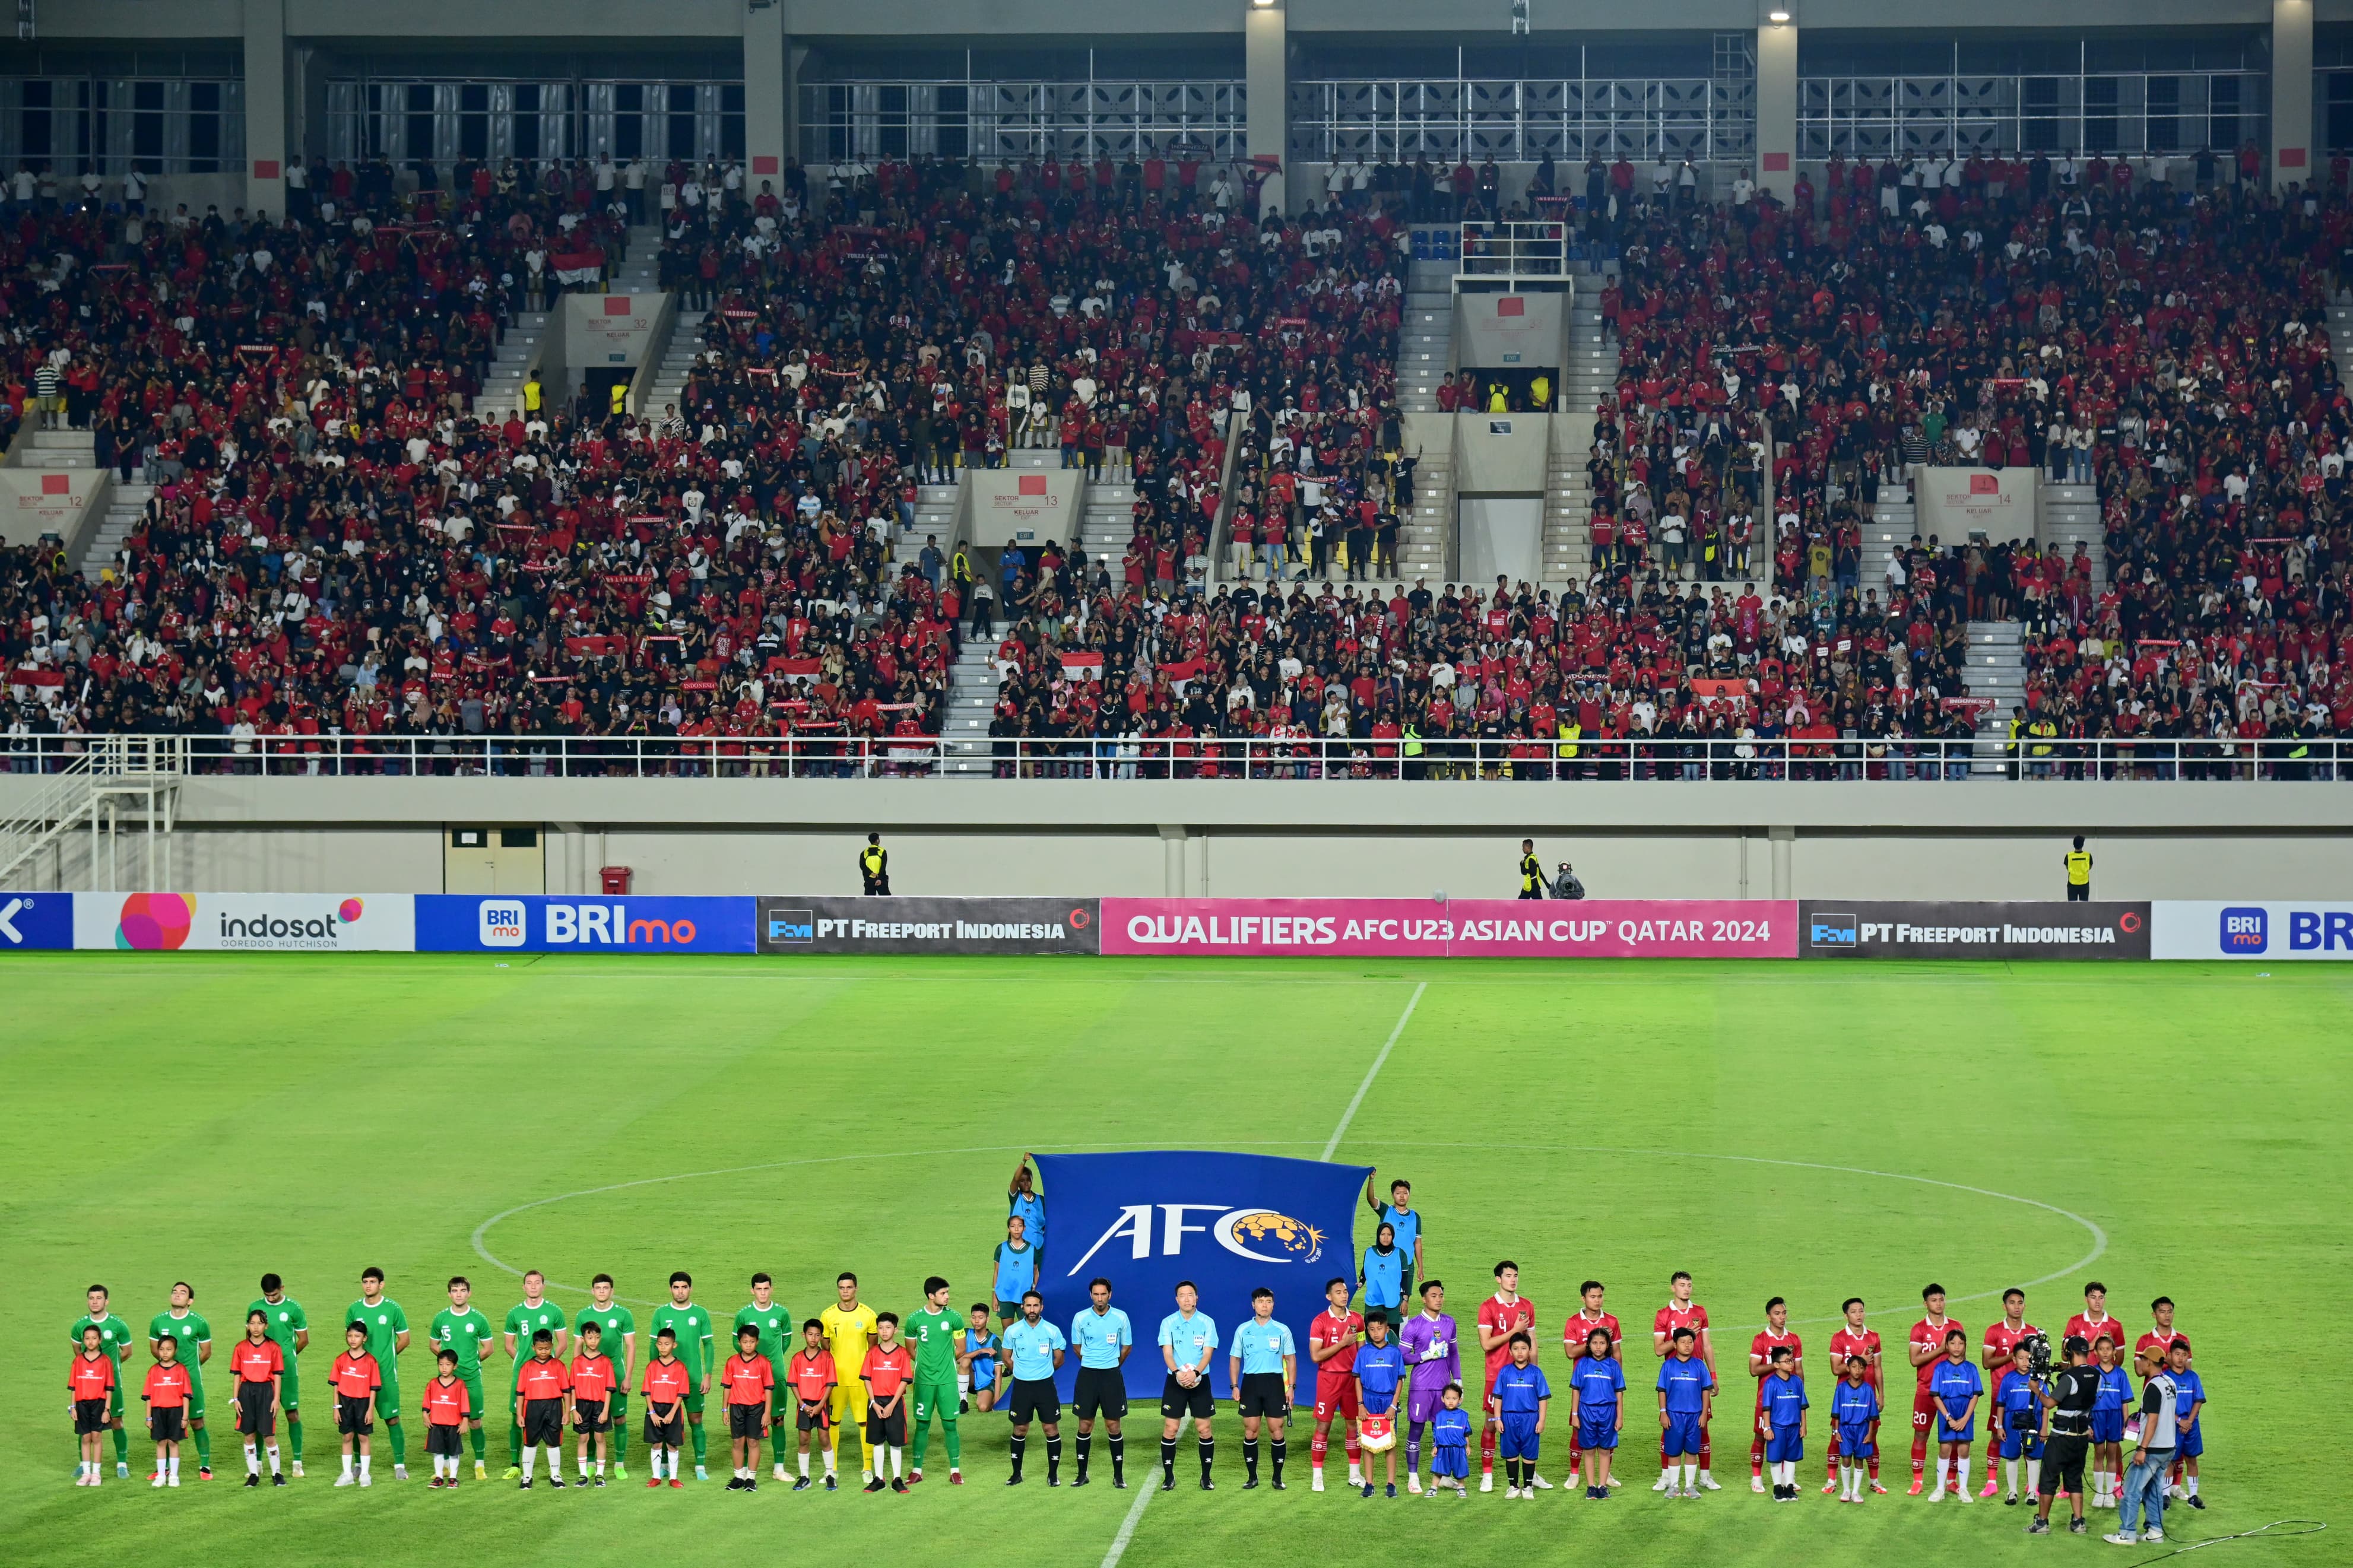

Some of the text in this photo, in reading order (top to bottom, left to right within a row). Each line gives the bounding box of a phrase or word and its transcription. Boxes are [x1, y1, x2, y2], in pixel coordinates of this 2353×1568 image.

[634, 319, 647, 329] 32
[69, 496, 82, 506] 12
[1045, 496, 1058, 506] 13
[1998, 494, 2011, 504] 14
[487, 909, 518, 925] BRI
[221, 912, 337, 938] indosat
[817, 919, 1065, 939] PT FREEPORT INDONESIA
[1127, 915, 1336, 944] QUALIFIERS
[1342, 919, 1398, 940] AFC
[1403, 919, 1454, 940] U23
[1459, 920, 1543, 941] ASIAN
[1618, 920, 1705, 945] QATAR
[1711, 921, 1770, 941] 2024
[2227, 916, 2260, 933] BRI
[493, 926, 519, 937] mo
[1861, 923, 2116, 943] PT FREEPORT INDONESIA
[2234, 934, 2262, 944] mo
[1067, 1204, 1292, 1276] AFC
[1309, 1255, 1319, 1263] AFC
[521, 1323, 529, 1336] 8
[835, 1326, 838, 1338] 1
[1499, 1319, 1507, 1332] 4
[921, 1328, 928, 1342] 2
[1921, 1341, 1937, 1353] 20
[2002, 1347, 2010, 1356] 7
[1488, 1394, 1495, 1408] 4
[916, 1402, 924, 1416] 2
[1318, 1402, 1325, 1415] 5
[1415, 1403, 1420, 1417] 1
[1913, 1411, 1927, 1425] 20
